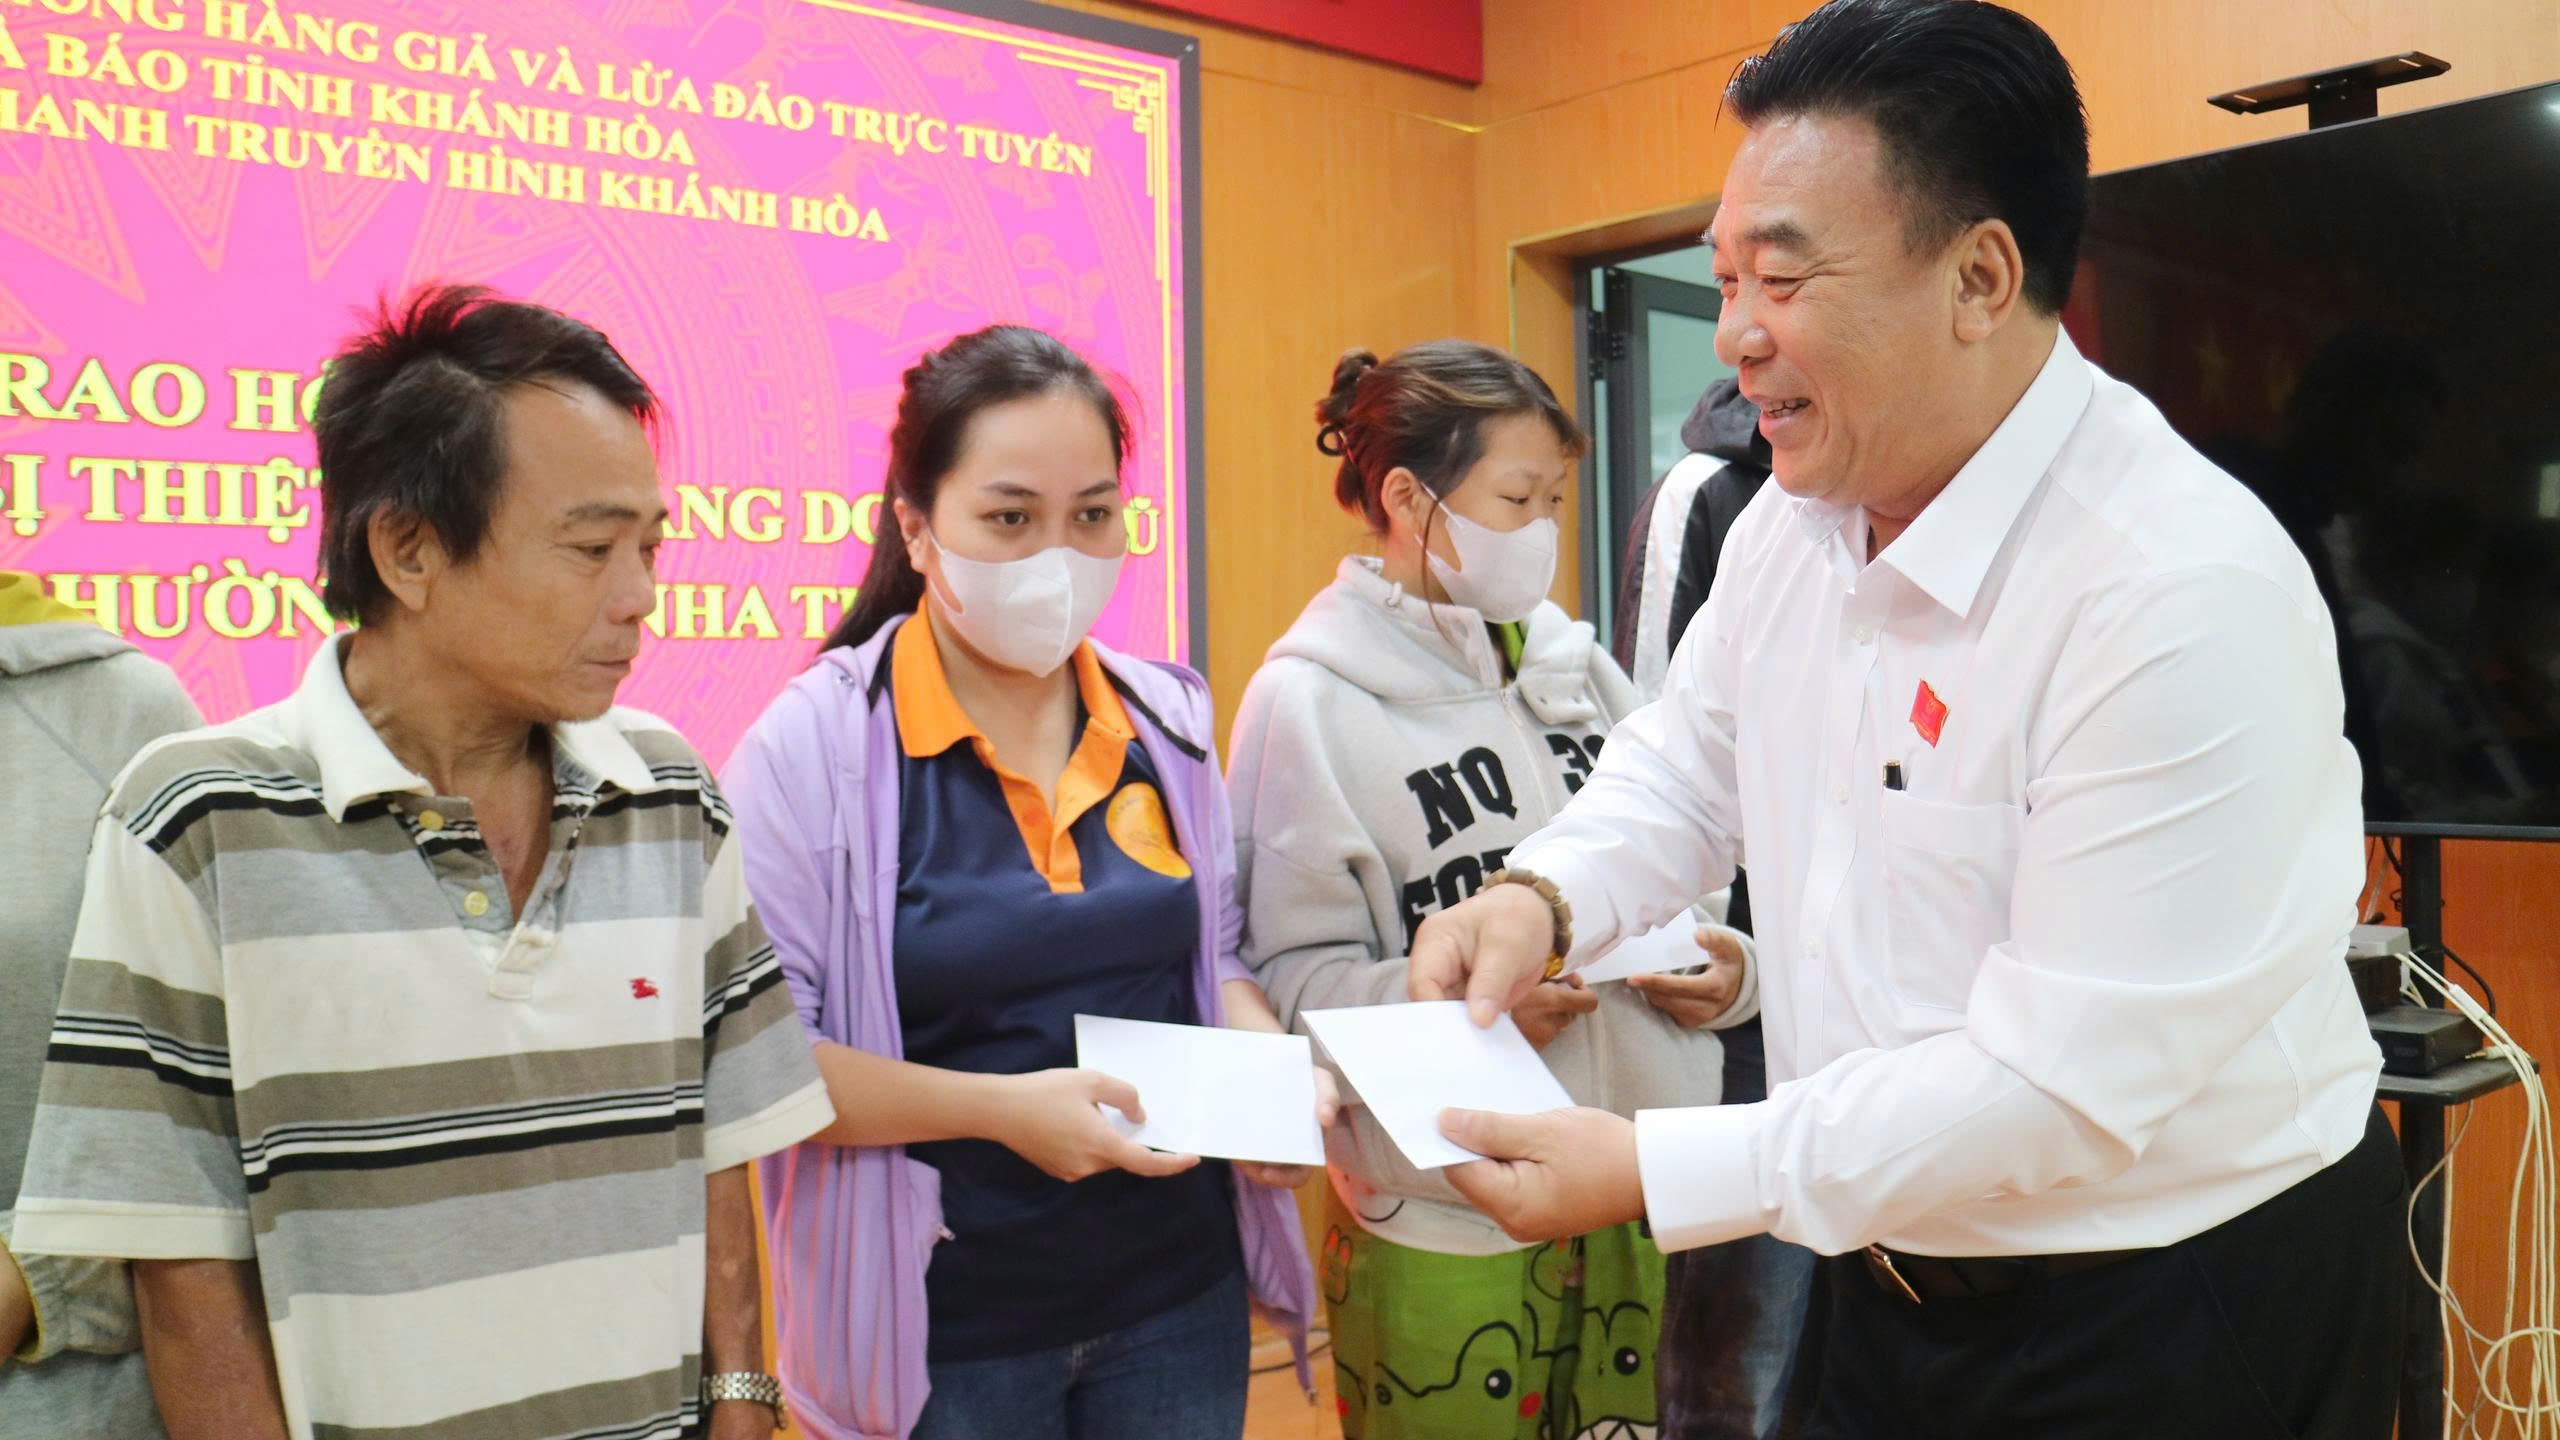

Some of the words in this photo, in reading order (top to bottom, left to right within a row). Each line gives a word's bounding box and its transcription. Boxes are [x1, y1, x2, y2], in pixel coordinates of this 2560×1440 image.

[43, 32, 189, 93] BÁO
[368, 82, 572, 150] KHÁNH
[583, 112, 696, 166] HÒA
[510, 46, 584, 96] VÀ
[597, 60, 703, 115] LỪA
[822, 101, 948, 156] TRỰC
[447, 144, 586, 204] HÌNH
[599, 169, 777, 229] KHÁNH
[789, 192, 890, 242] HÒA
[0, 352, 206, 427] RAO
[229, 360, 335, 433] H
[0, 454, 46, 536] Ị
[69, 456, 322, 543] THIỆ
[1122, 495, 1160, 555] Ũ
[46, 558, 360, 640] HƯỜN
[1405, 746, 1517, 850] NQ
[1402, 846, 1515, 957] FO
